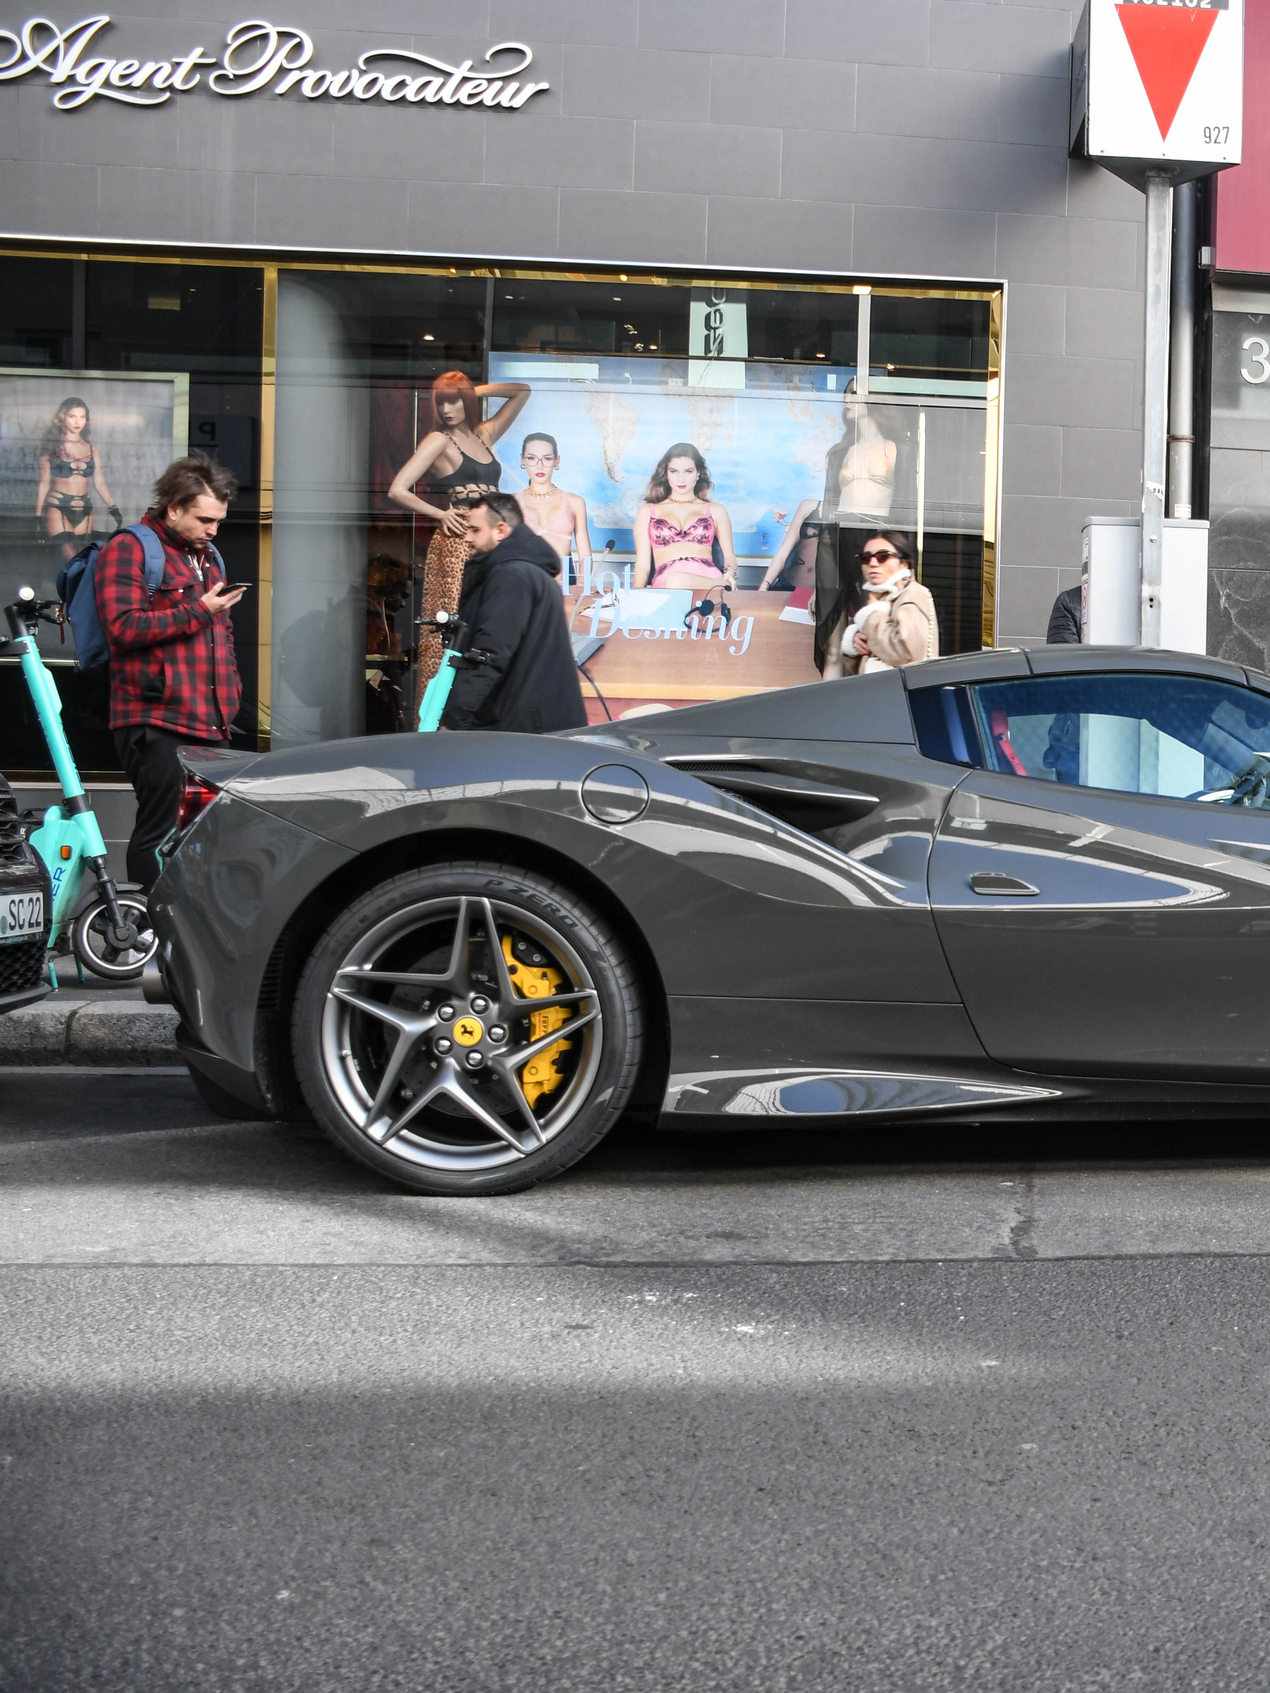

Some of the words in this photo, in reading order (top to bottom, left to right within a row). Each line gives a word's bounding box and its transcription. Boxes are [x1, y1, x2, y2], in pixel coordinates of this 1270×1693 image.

[0, 15, 217, 109] Agent
[208, 20, 550, 109] Provocateur
[1203, 126, 1230, 144] 927
[562, 556, 635, 596] Hot
[9, 899, 25, 931] SC
[28, 896, 42, 928] 22
